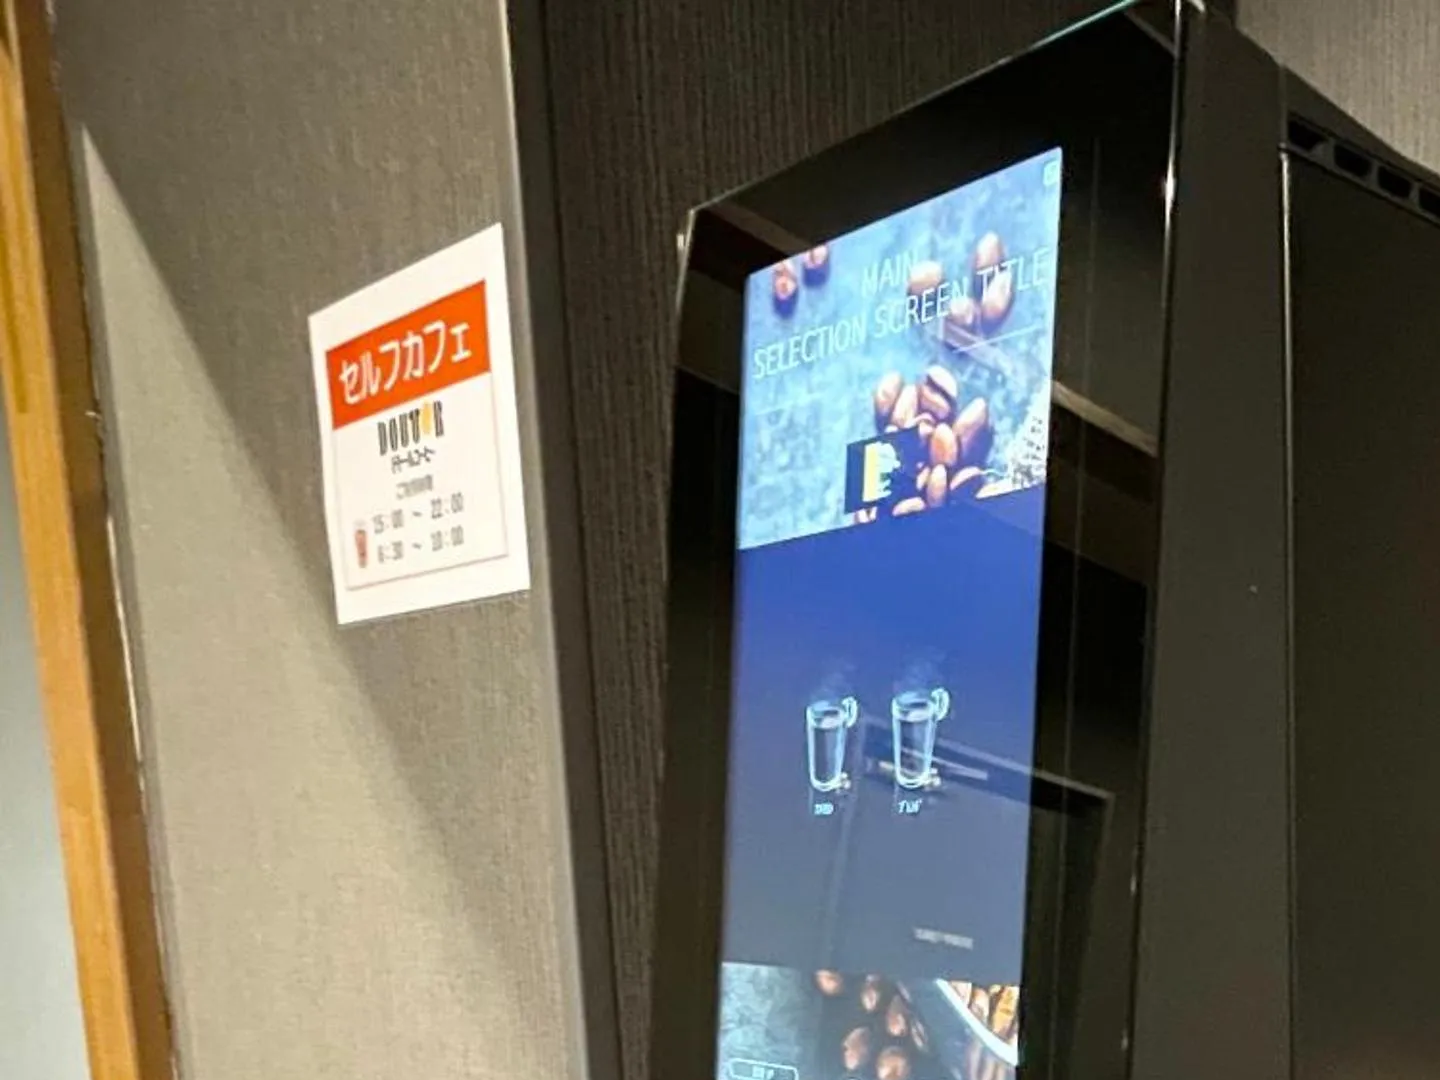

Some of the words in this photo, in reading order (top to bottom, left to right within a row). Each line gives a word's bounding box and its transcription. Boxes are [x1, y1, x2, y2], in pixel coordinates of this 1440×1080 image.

[752, 316, 868, 381] SELECTION
[874, 278, 970, 339] SCREEN
[976, 246, 1050, 301] TITLE
[860, 250, 919, 297] MAIN
[338, 319, 472, 405] セルフカフェ
